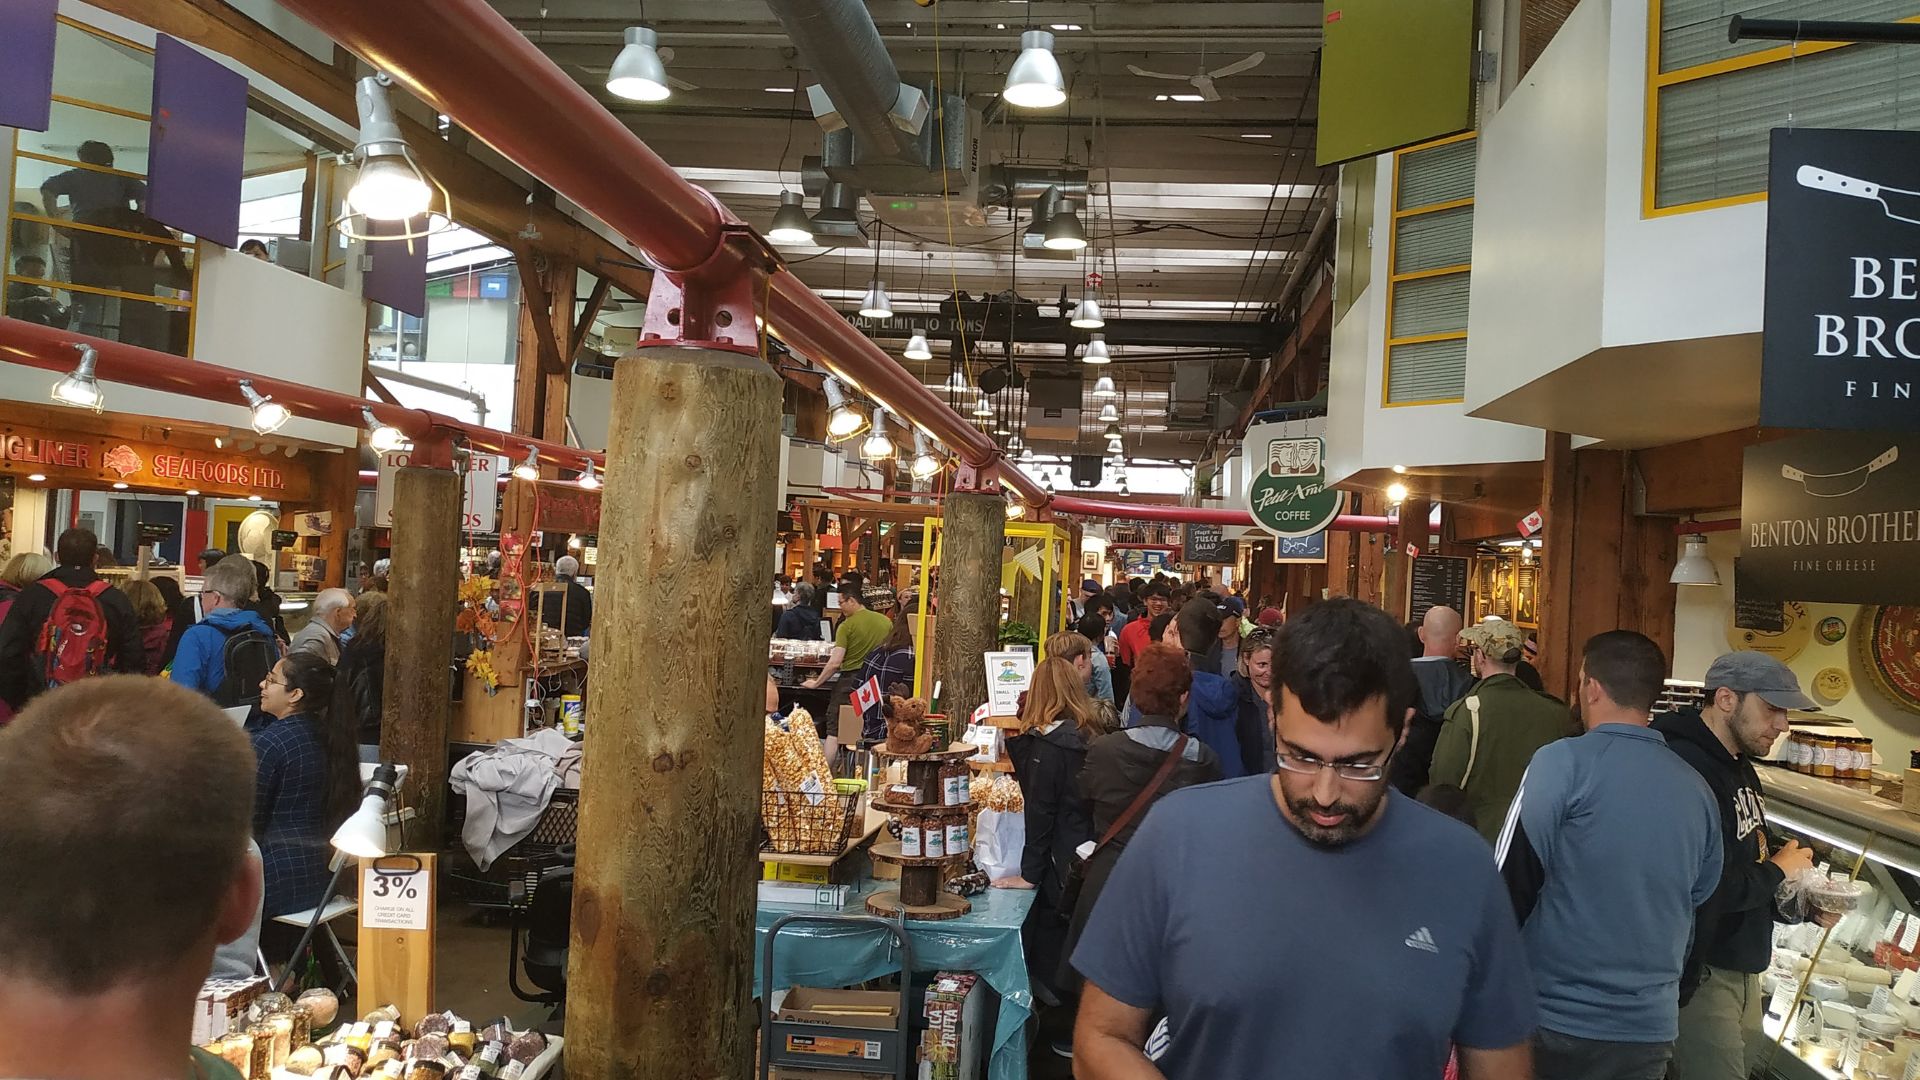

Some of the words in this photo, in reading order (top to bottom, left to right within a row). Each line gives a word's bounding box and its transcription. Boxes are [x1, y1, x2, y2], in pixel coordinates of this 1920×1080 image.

[881, 317, 916, 330] LIMIT
[950, 319, 984, 332] TONS
[152, 454, 249, 485] SEAFOODS
[253, 468, 286, 490] LTD.
[1254, 487, 1294, 512] Petit
[1274, 510, 1311, 521] COFFEE
[1751, 518, 1820, 548] BENTON
[1194, 543, 1216, 551] SALAD
[1793, 560, 1820, 572] FINE
[1826, 559, 1877, 572] CHEESE
[373, 876, 417, 898] 3%
[942, 1009, 958, 1048] FRUTA
